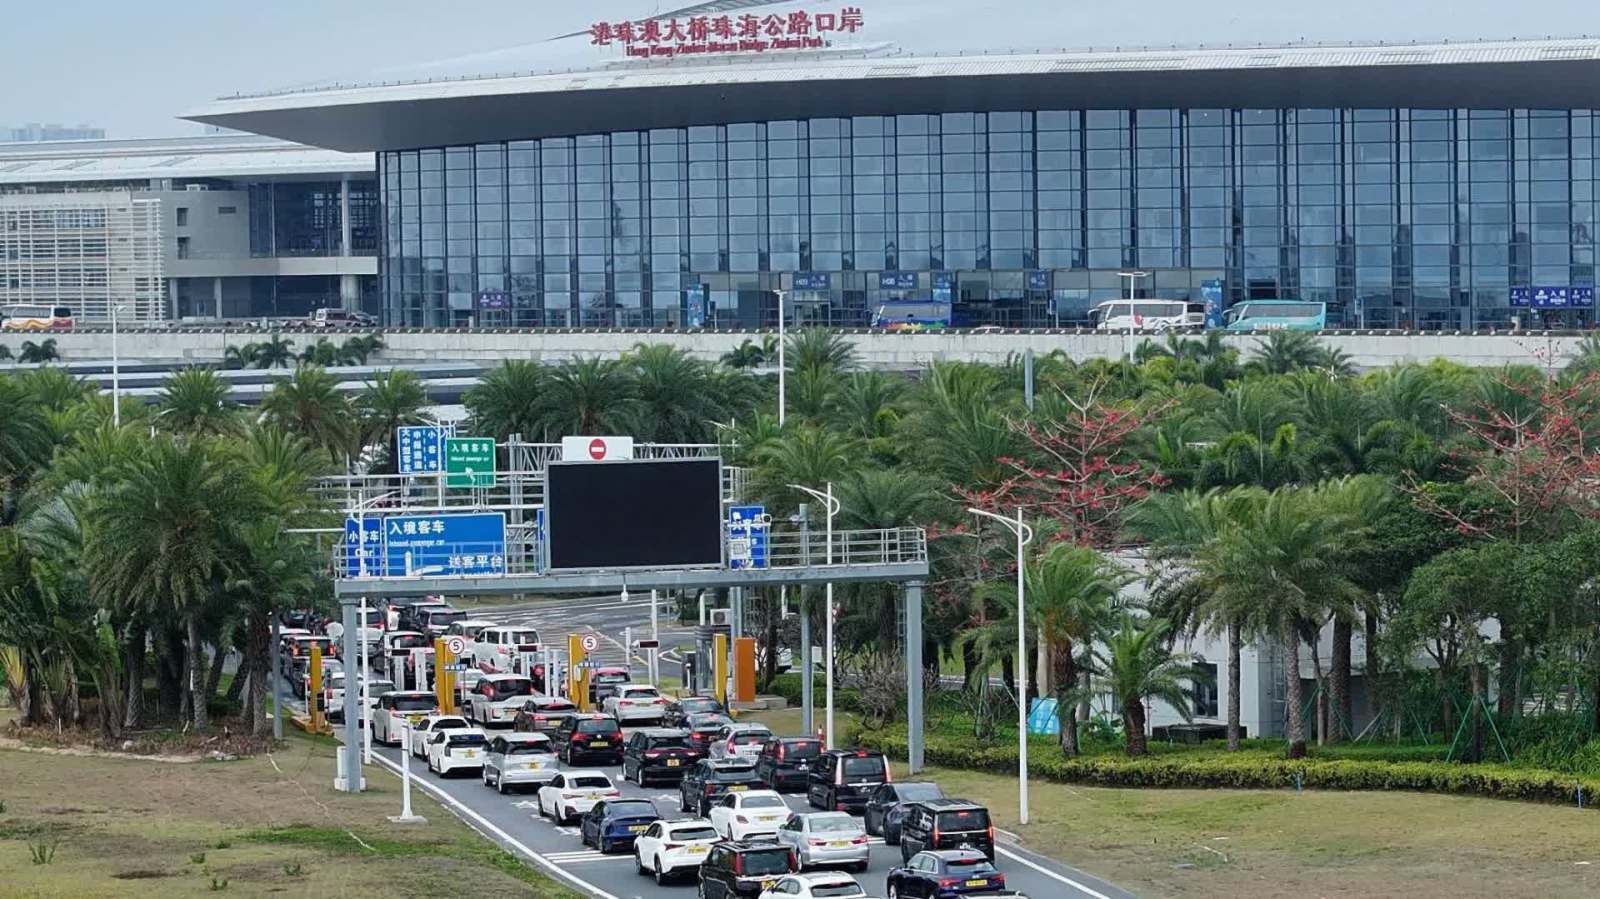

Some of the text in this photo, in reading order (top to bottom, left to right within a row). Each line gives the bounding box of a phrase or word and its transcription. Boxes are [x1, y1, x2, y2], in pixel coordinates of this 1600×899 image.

[590, 7, 865, 46] 港珠澳大桥珠海公路口岸
[452, 443, 489, 453] 入境客车
[389, 520, 446, 535] 入境客车
[348, 530, 379, 543] 小客车
[448, 553, 503, 568] 送客平台
[453, 641, 460, 650] 5
[586, 638, 593, 648] 5
